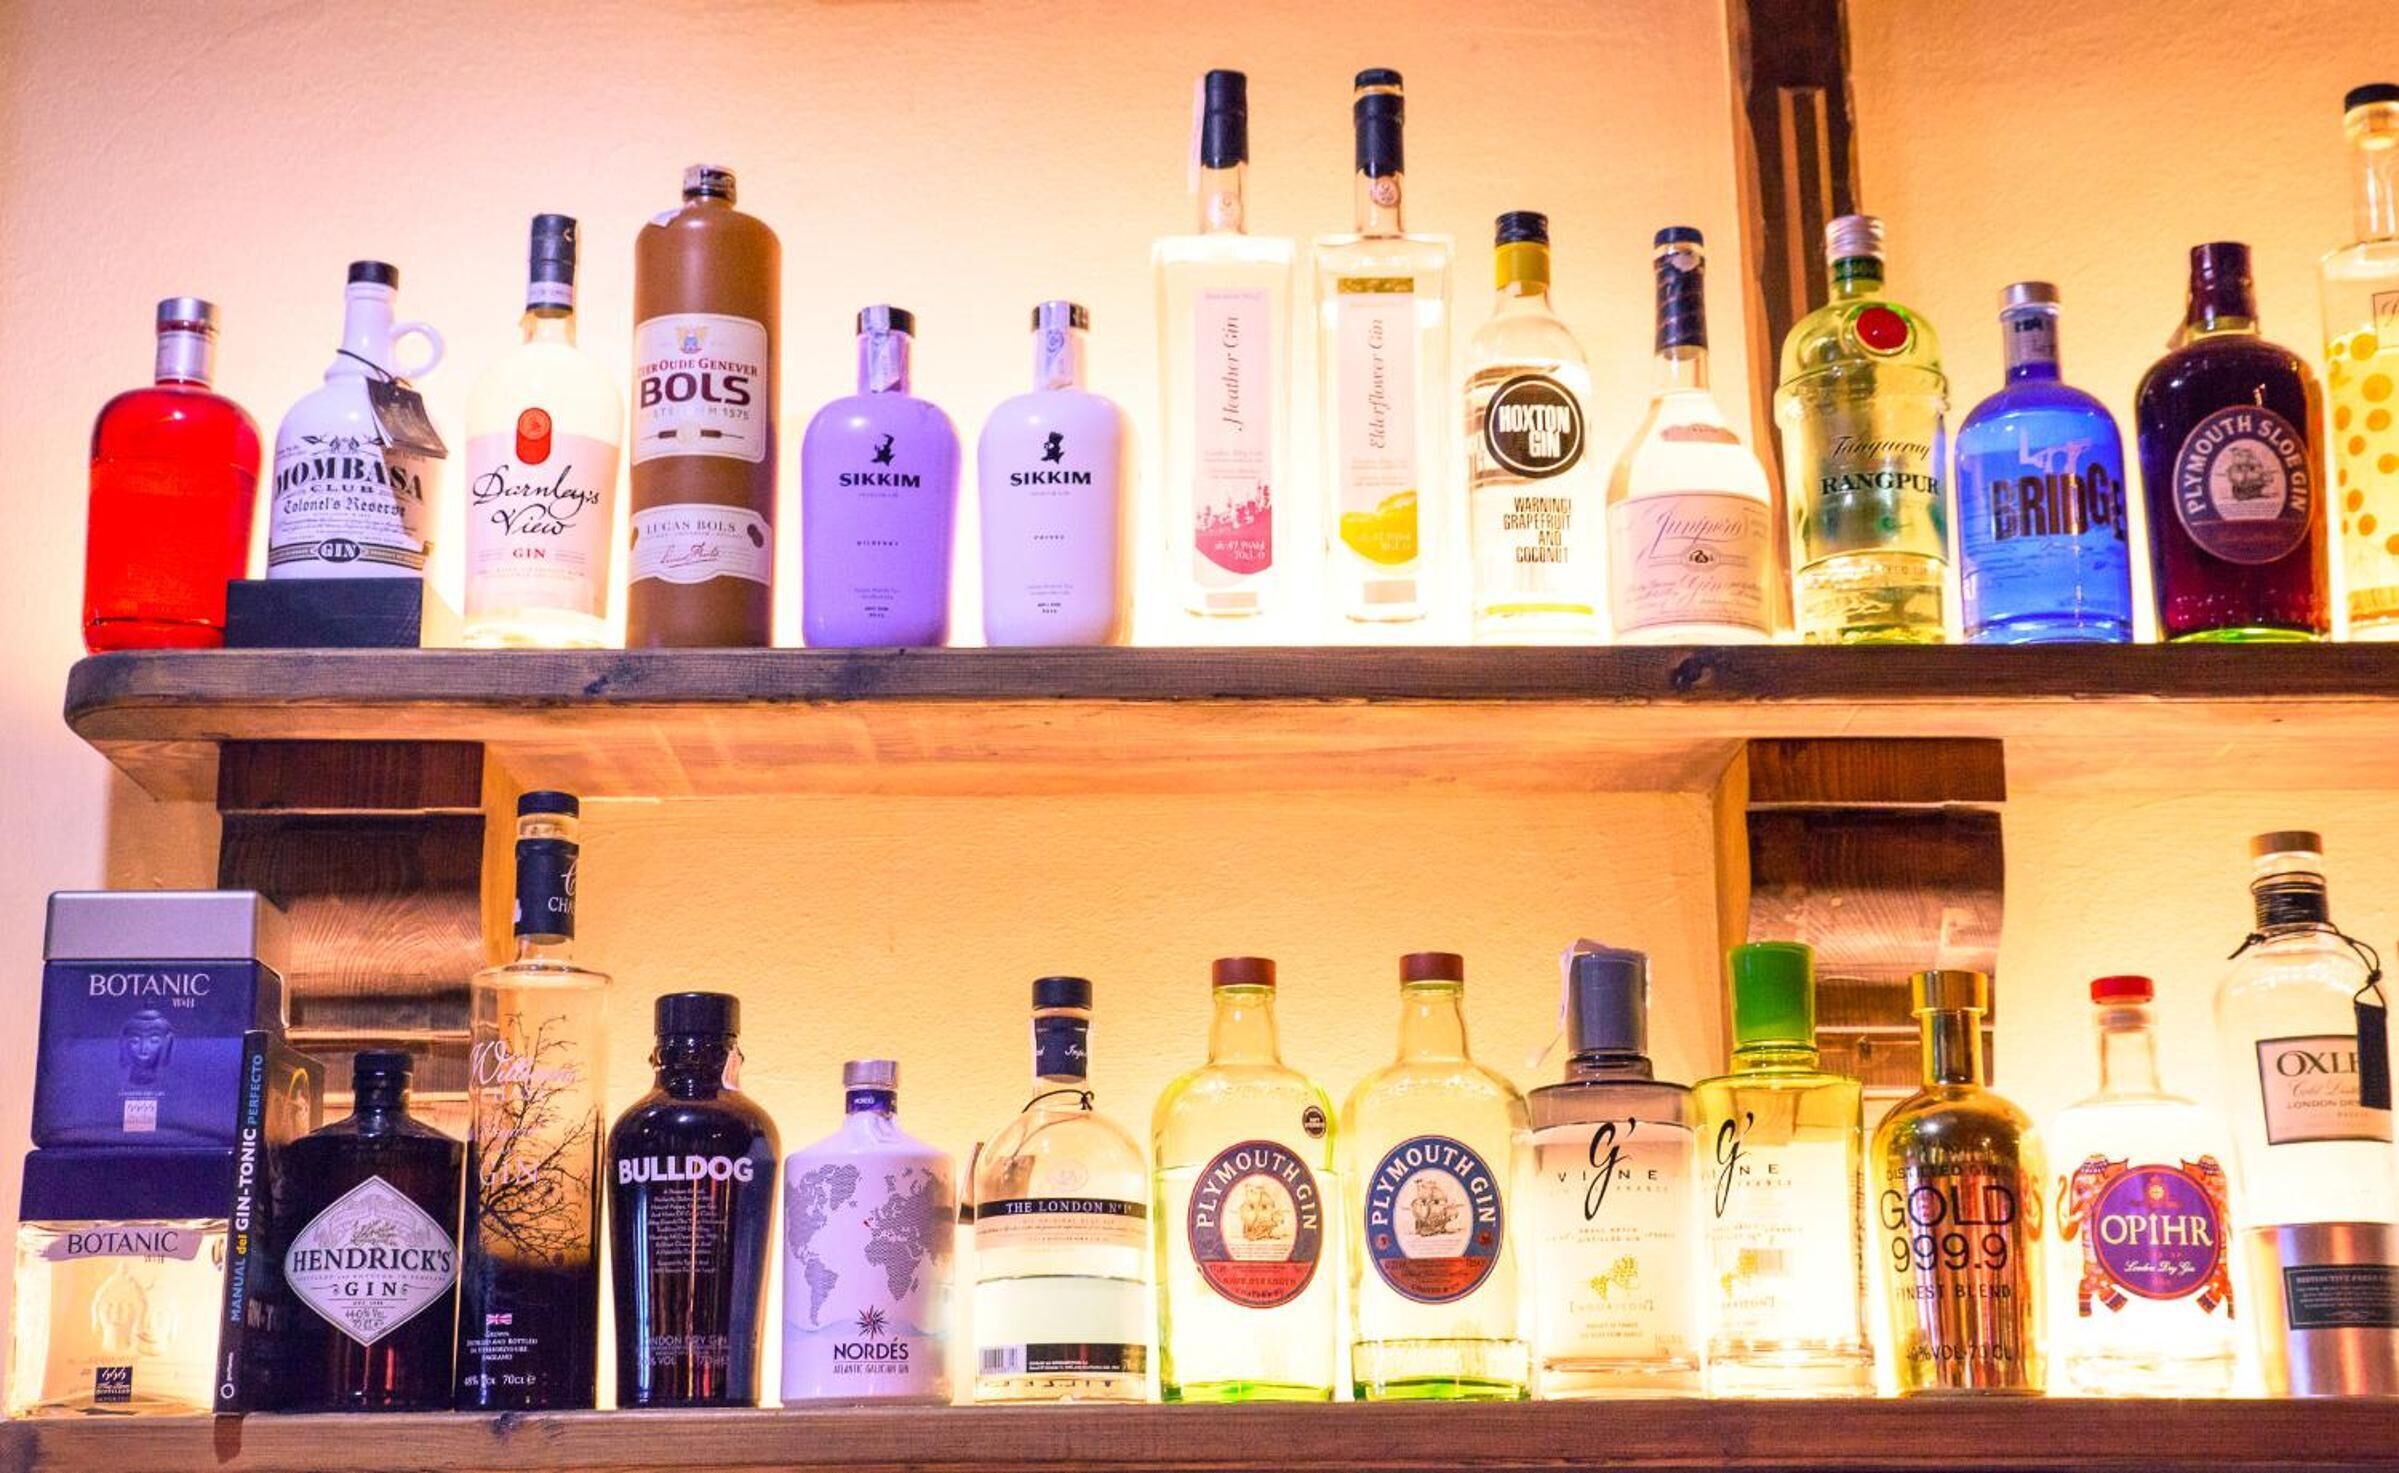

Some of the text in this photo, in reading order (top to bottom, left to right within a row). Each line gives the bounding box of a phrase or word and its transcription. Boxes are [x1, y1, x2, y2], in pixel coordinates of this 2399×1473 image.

[698, 357, 758, 377] GENEVER
[640, 372, 752, 411] BOLS
[1499, 404, 1571, 433] HOXTON
[1528, 432, 1561, 458] GIN
[1833, 435, 1930, 461] Tanqueray
[2184, 414, 2308, 514] PLYMOUTH SLOE GIN
[310, 484, 374, 494] CLUB
[839, 472, 921, 488] SIKKIM
[1010, 471, 1092, 487] SIKKIM
[1821, 471, 1939, 496] RANGPUR
[473, 464, 600, 520] Darnley's
[1514, 496, 1572, 513] WARNING!
[491, 503, 577, 537] View
[696, 519, 738, 533] BOLS
[1503, 513, 1571, 530] GRAPEFRUIT
[321, 542, 358, 559] GIN
[1538, 531, 1562, 546] AND
[513, 548, 546, 559] GIN
[88, 973, 211, 997] BOTANIC
[248, 1054, 264, 1125] PERFECTO
[235, 1128, 258, 1232] GIN-TONIC
[618, 1154, 754, 1185] BULLDOG
[1196, 1149, 1318, 1231] PLYMOUTH GIN
[1371, 1144, 1496, 1226] PLYMOUTH GIN
[1005, 1203, 1032, 1214] THE
[1039, 1201, 1103, 1214] LONDON
[1880, 1185, 2016, 1231] GOLD
[2100, 1213, 2214, 1247] OPIHR
[68, 1231, 179, 1255] BOTANIC
[1892, 1232, 2008, 1273] 999.9
[293, 1247, 452, 1273] HENDRICK'S
[230, 1259, 247, 1322] MANUAL
[345, 1282, 397, 1296] GIN
[1955, 1285, 2012, 1299] BLEND
[833, 1336, 910, 1361] NORDÉS
